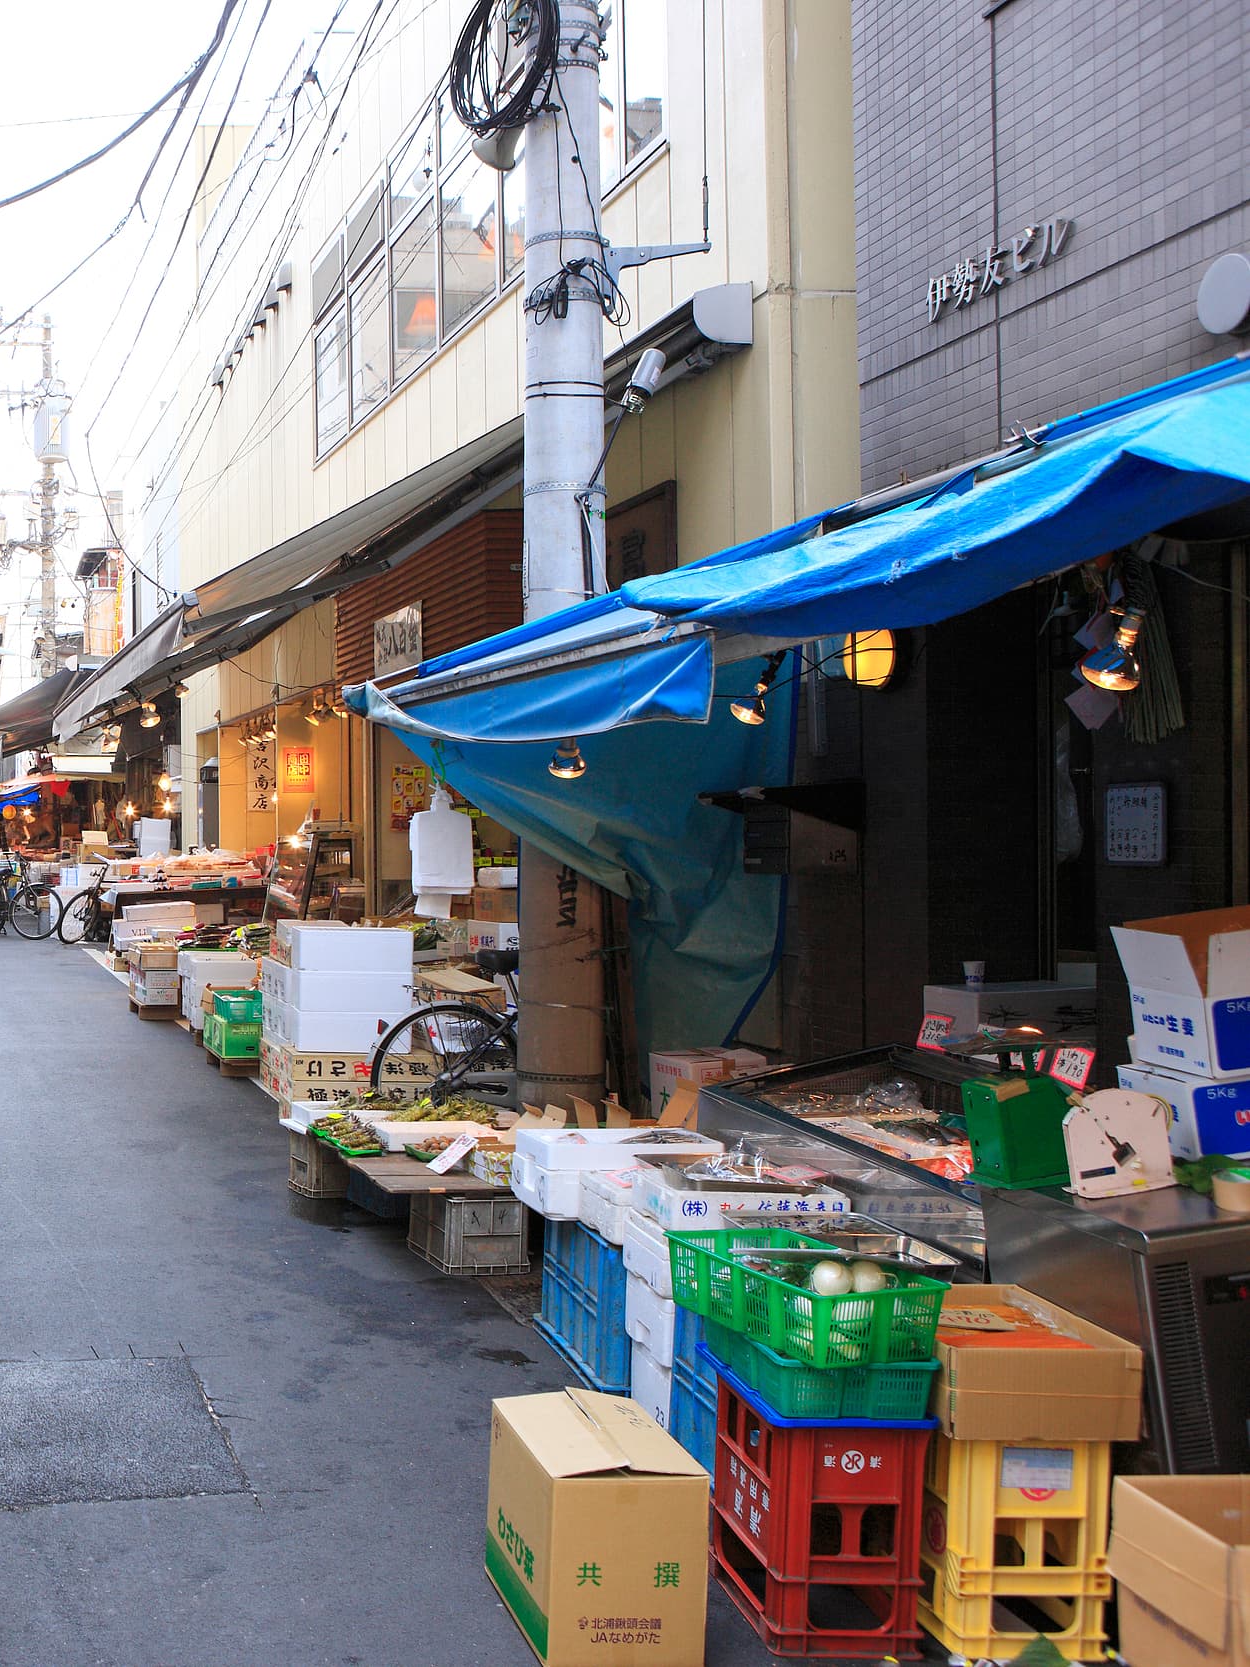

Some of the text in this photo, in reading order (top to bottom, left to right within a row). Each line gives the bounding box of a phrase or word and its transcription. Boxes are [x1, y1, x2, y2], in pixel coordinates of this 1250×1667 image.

[925, 218, 1074, 323] 伊勢友ビル
[1207, 1087, 1238, 1099] 5Kg
[682, 1199, 708, 1217] (株)
[591, 1632, 662, 1645] JAなめがた
